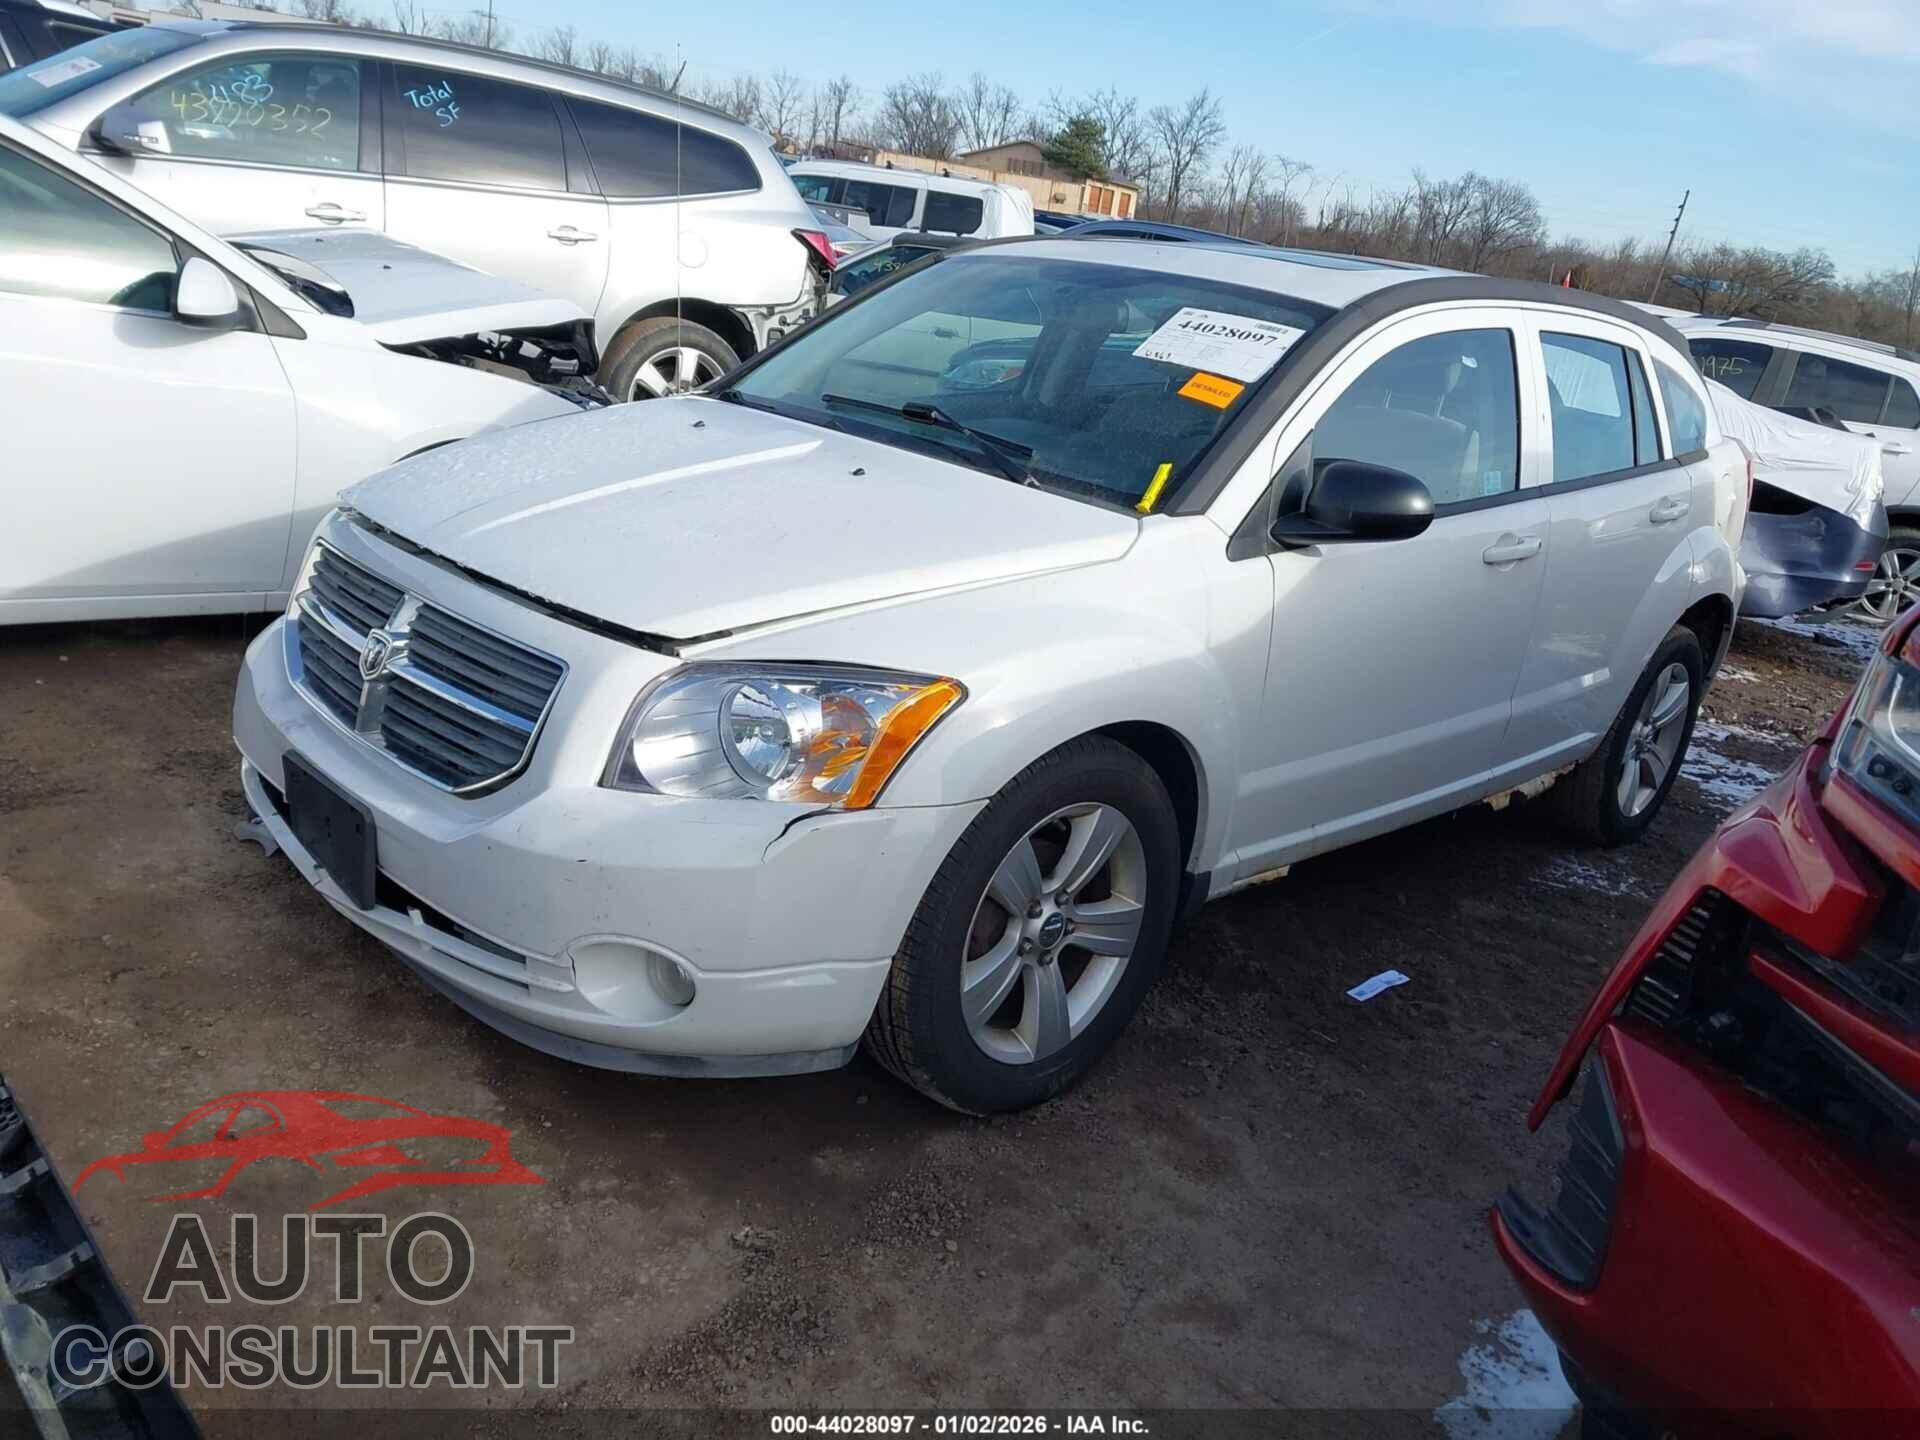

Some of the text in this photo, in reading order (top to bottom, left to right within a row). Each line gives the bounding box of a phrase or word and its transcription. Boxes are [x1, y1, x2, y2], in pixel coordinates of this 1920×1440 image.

[403, 80, 453, 108] Total
[436, 101, 460, 128] SF
[1178, 320, 1278, 345] 44028097
